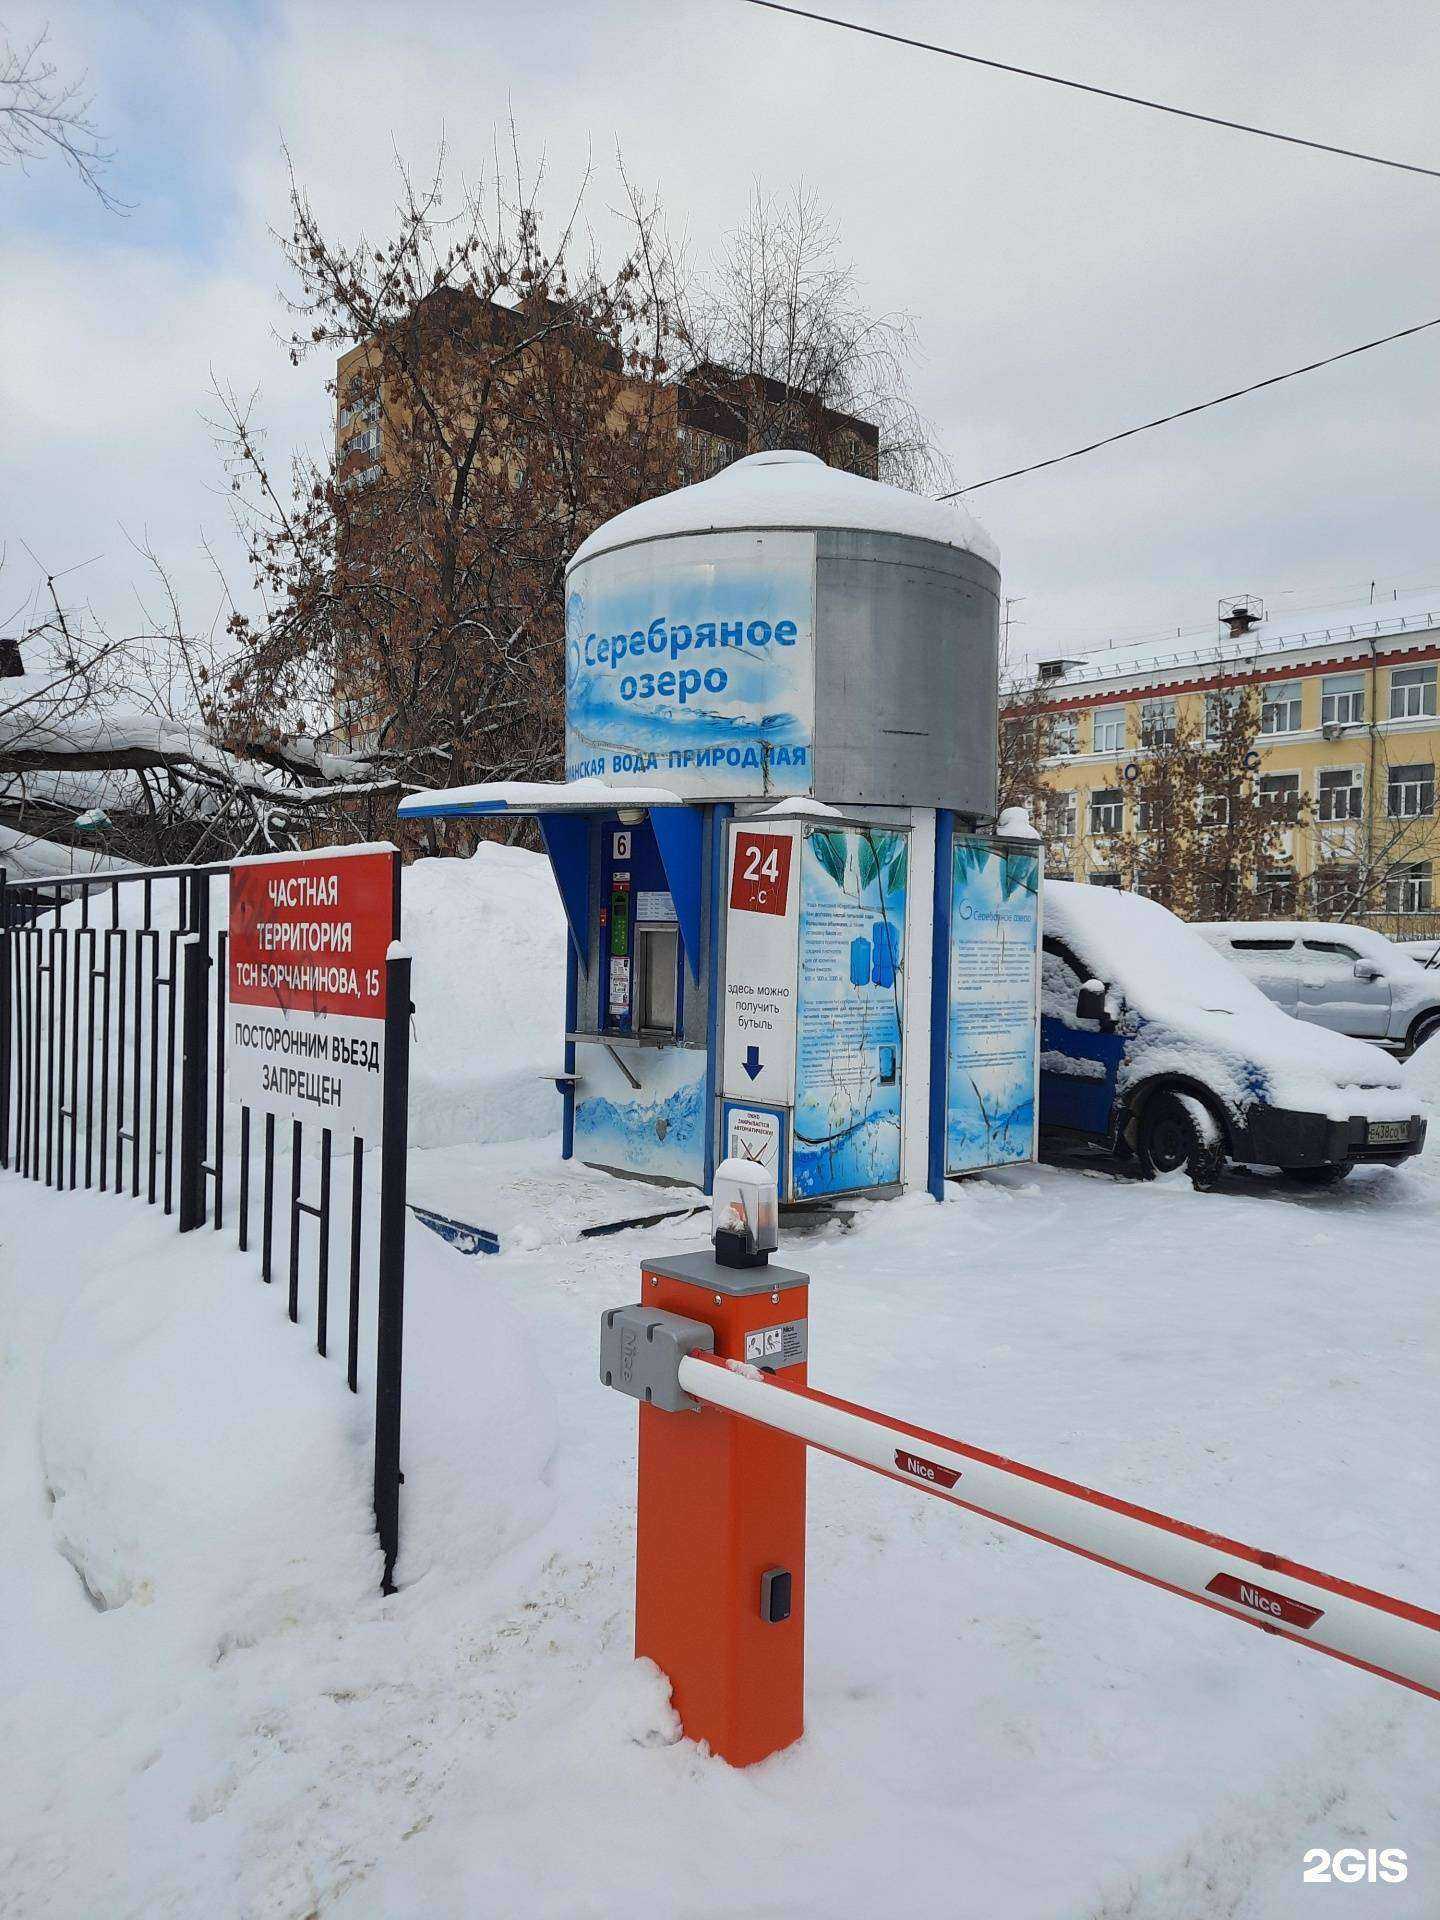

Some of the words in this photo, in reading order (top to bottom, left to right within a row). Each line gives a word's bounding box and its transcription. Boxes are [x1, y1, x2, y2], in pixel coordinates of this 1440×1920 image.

[584, 617, 798, 669] Серебряное
[619, 667, 729, 703] озеро
[612, 750, 658, 774] ВОДА
[617, 834, 627, 856] 6
[743, 846, 778, 883] 24
[268, 875, 338, 908] ЧАСТНАЯ
[256, 922, 352, 952] ТЕРРИТОРИЯ
[236, 963, 258, 986] ТСН
[260, 964, 361, 998] БОРЧАНИНОВА,
[365, 970, 379, 997] 15
[727, 984, 754, 997] здесь
[757, 986, 789, 997] можно
[735, 1001, 780, 1014] получить
[738, 1016, 773, 1030] бутыль
[235, 1023, 328, 1060] ПОСТОРОННИМ
[332, 1036, 380, 1073] ВЪЕЗД
[262, 1064, 342, 1107] ЗАПРЕЩЕН
[907, 1458, 934, 1480] Nice
[1240, 1585, 1281, 1616] Nice
